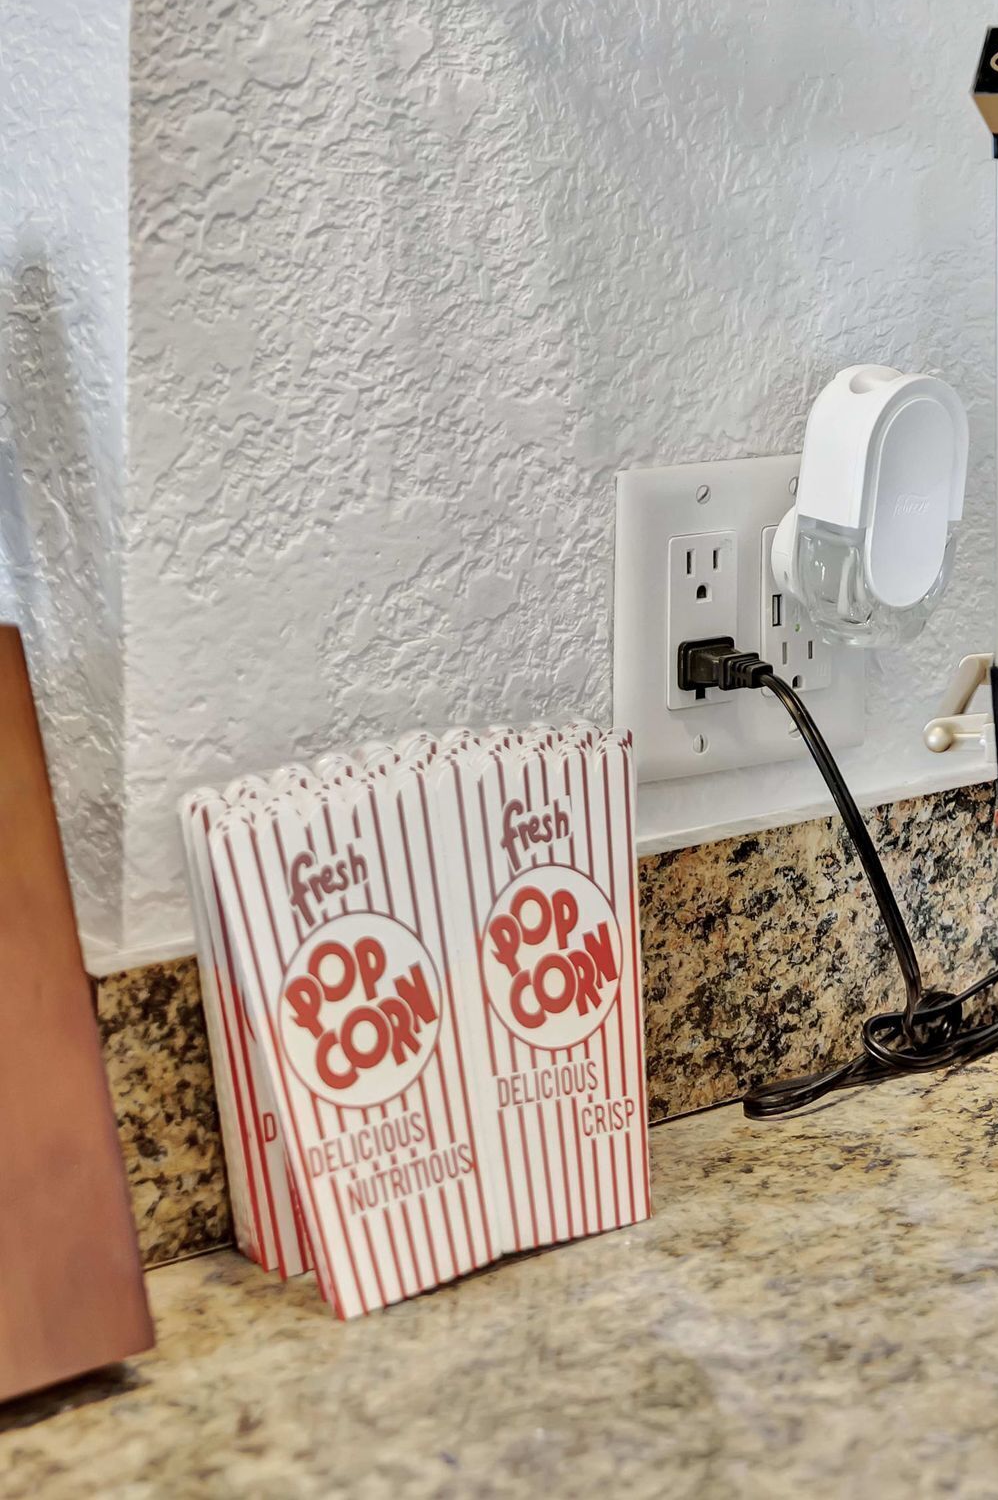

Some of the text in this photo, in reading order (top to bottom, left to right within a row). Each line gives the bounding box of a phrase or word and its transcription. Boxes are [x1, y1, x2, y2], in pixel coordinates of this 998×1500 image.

[500, 798, 571, 872] fresh
[290, 843, 368, 927] fresh
[488, 885, 580, 977] POP
[285, 936, 386, 1039] POP
[509, 920, 619, 1029] CORN
[315, 961, 438, 1090] CORN
[497, 1060, 599, 1108] DELICIOUS
[581, 1098, 636, 1138] CRISP
[308, 1110, 427, 1178] DELICIOUS
[346, 1143, 475, 1216] NUTRITIOUS
